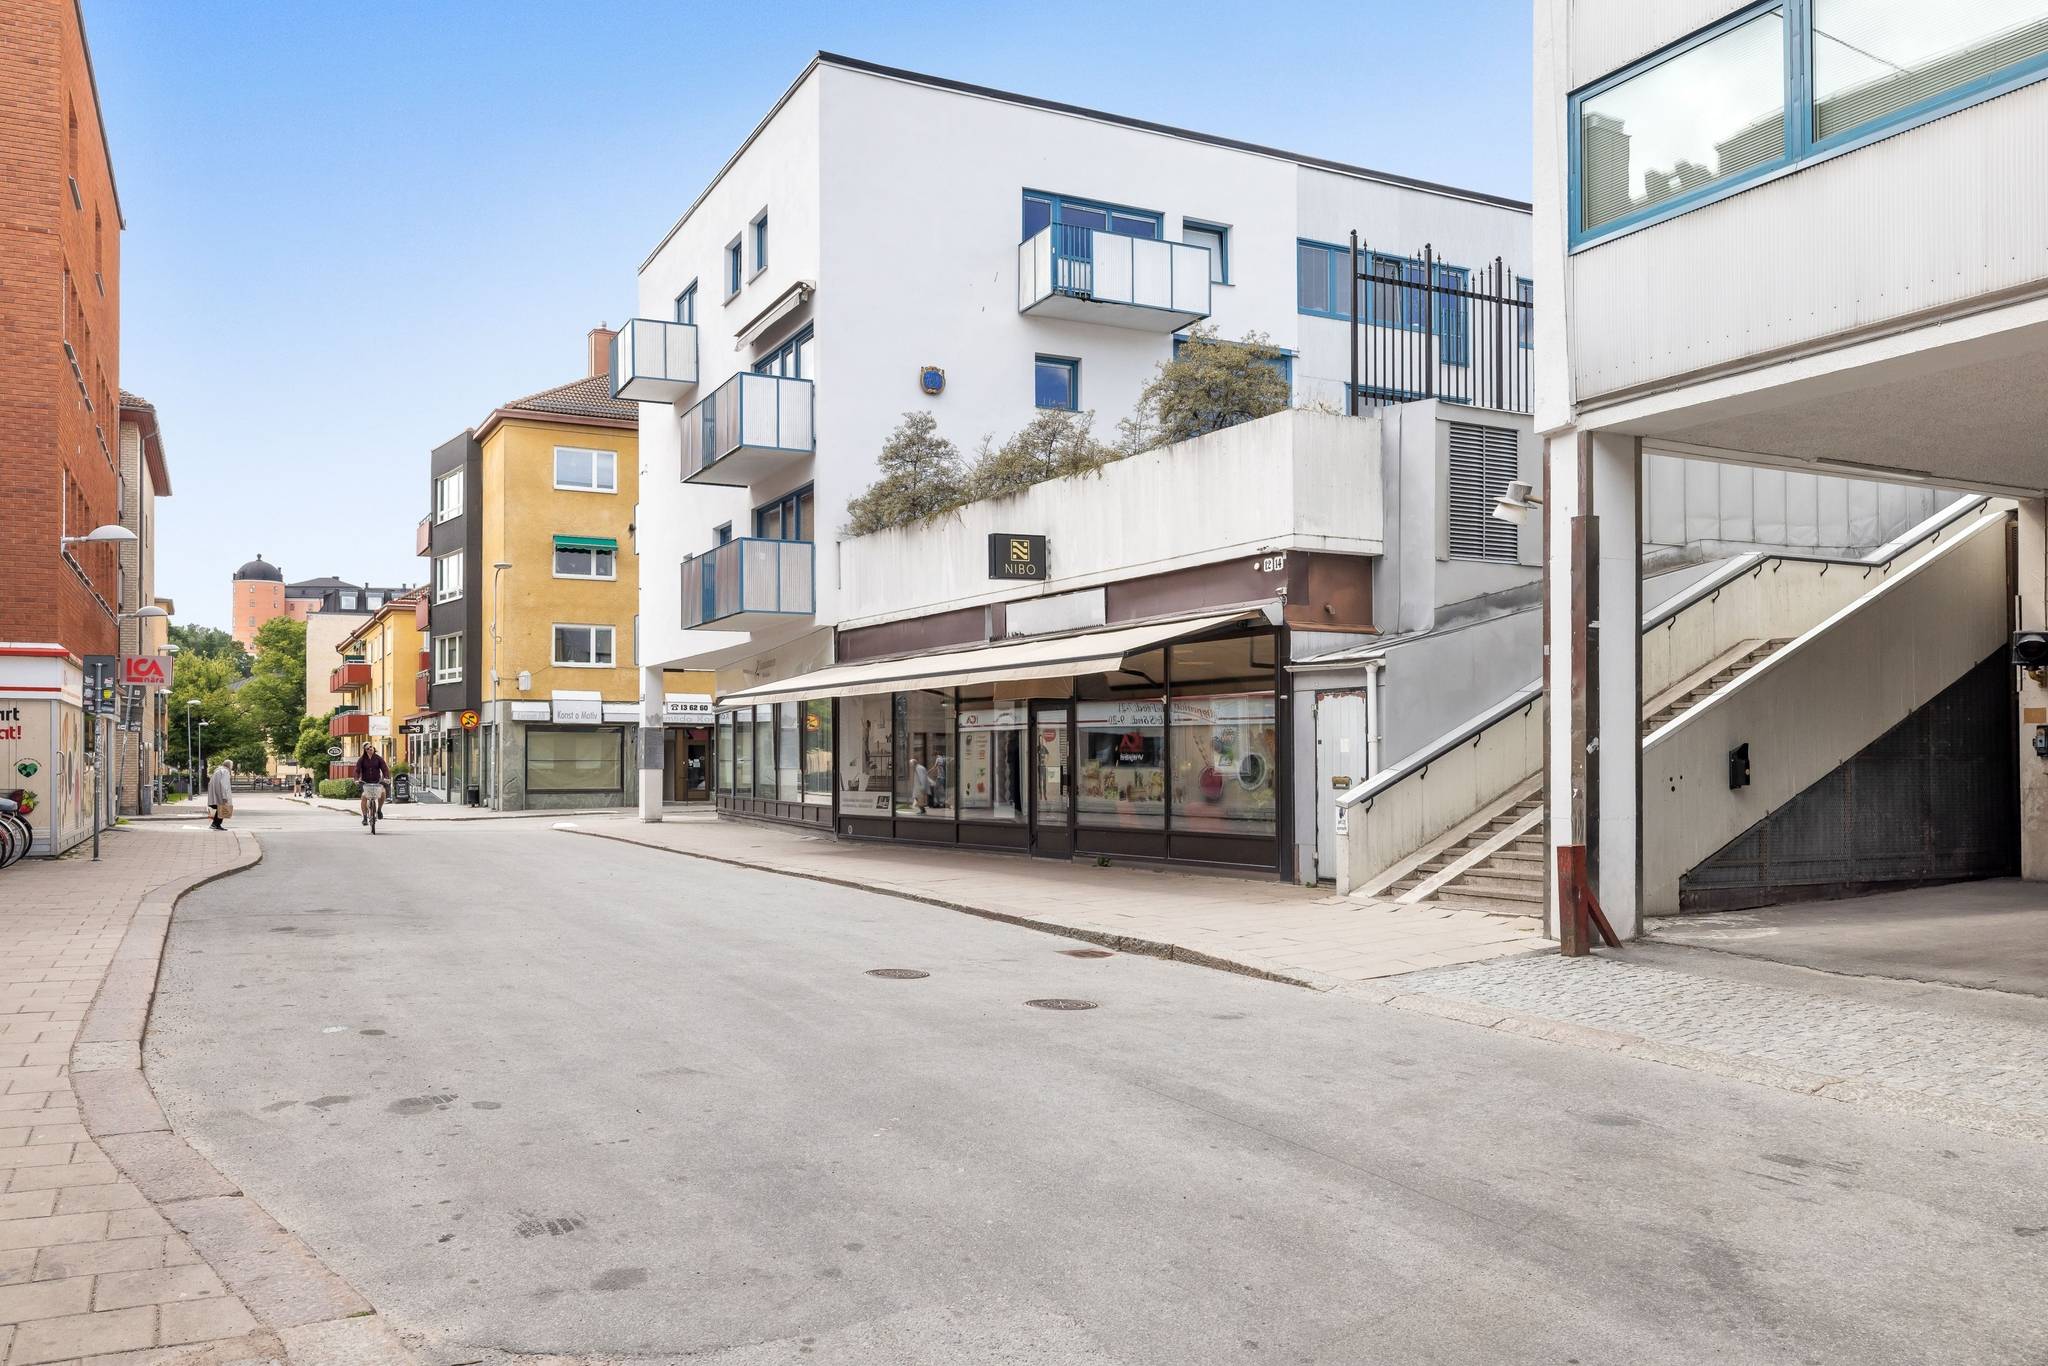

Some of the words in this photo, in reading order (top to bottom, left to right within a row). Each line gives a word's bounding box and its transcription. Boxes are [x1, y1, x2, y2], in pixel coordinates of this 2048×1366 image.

[1004, 563, 1036, 575] NIBO
[1275, 557, 1283, 569] 14
[126, 658, 165, 677] ICA
[557, 710, 574, 720] Konst
[580, 710, 598, 720] Motiv
